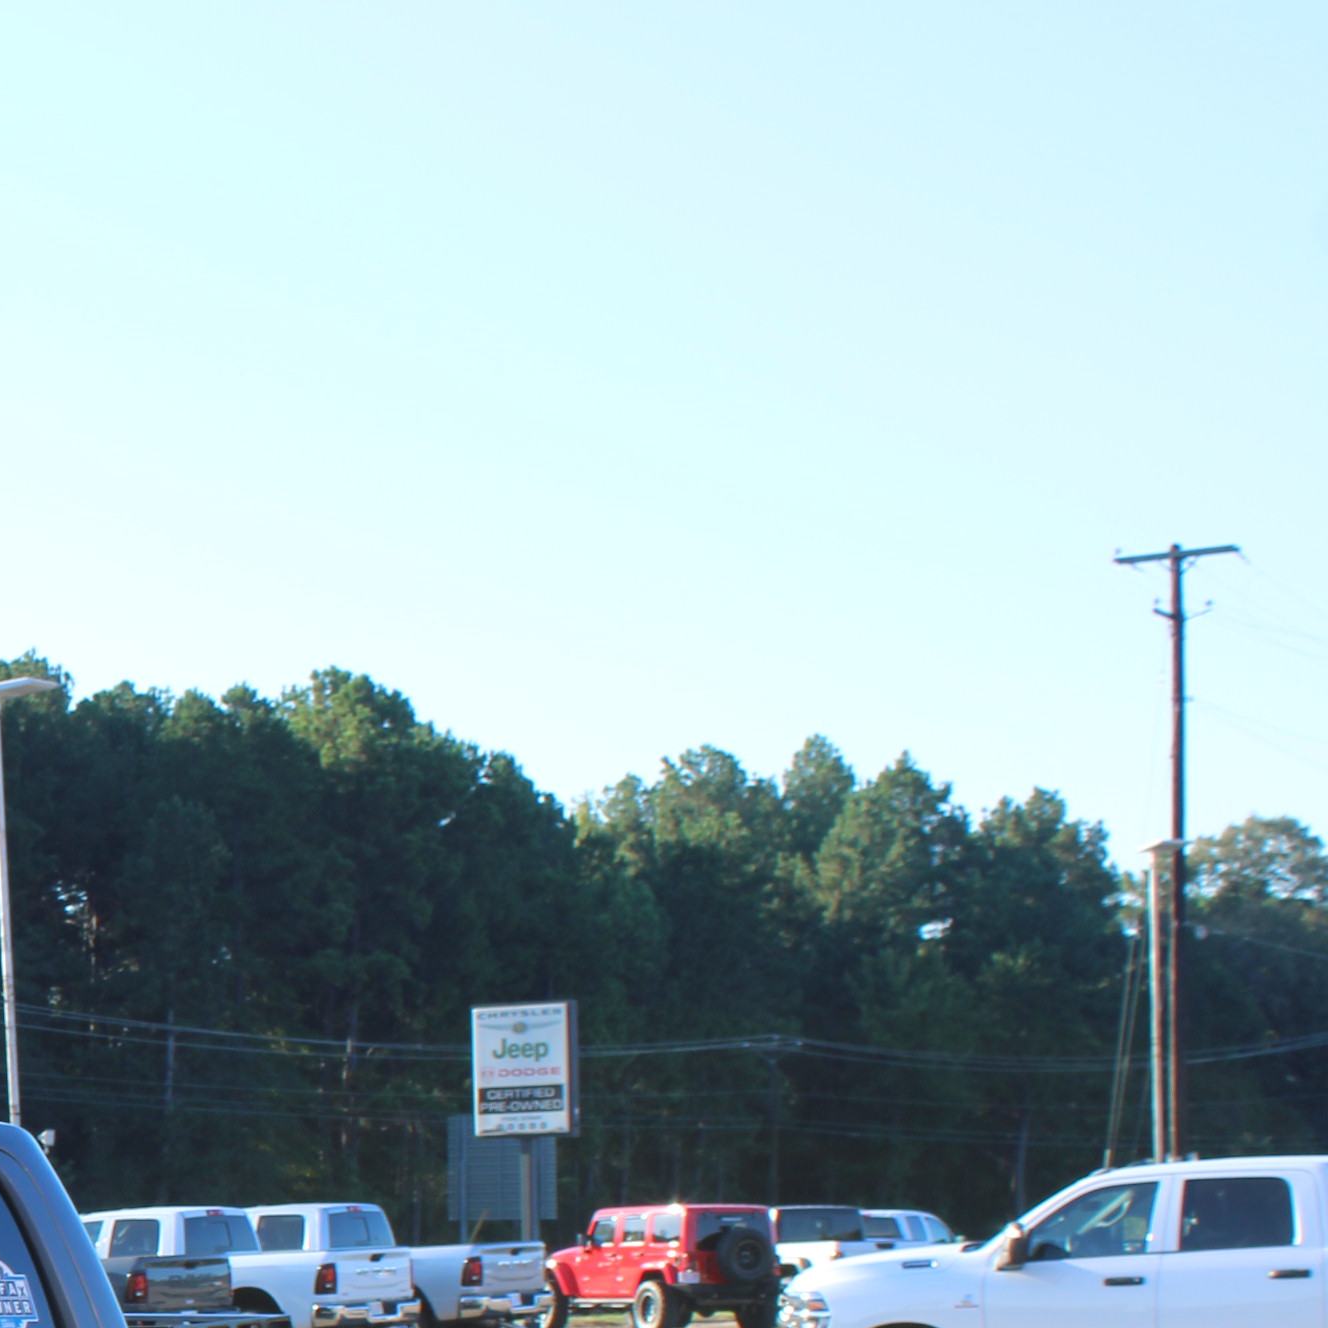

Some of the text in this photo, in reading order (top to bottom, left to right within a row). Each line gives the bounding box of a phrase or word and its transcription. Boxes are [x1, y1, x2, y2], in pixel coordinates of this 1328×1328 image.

[477, 1008, 562, 1020] CHRYSLER
[492, 1038, 548, 1061] Jeep
[498, 1067, 559, 1077] DODGE
[487, 1088, 555, 1100] CERTIFIED
[480, 1100, 562, 1112] PRE-OWNED
